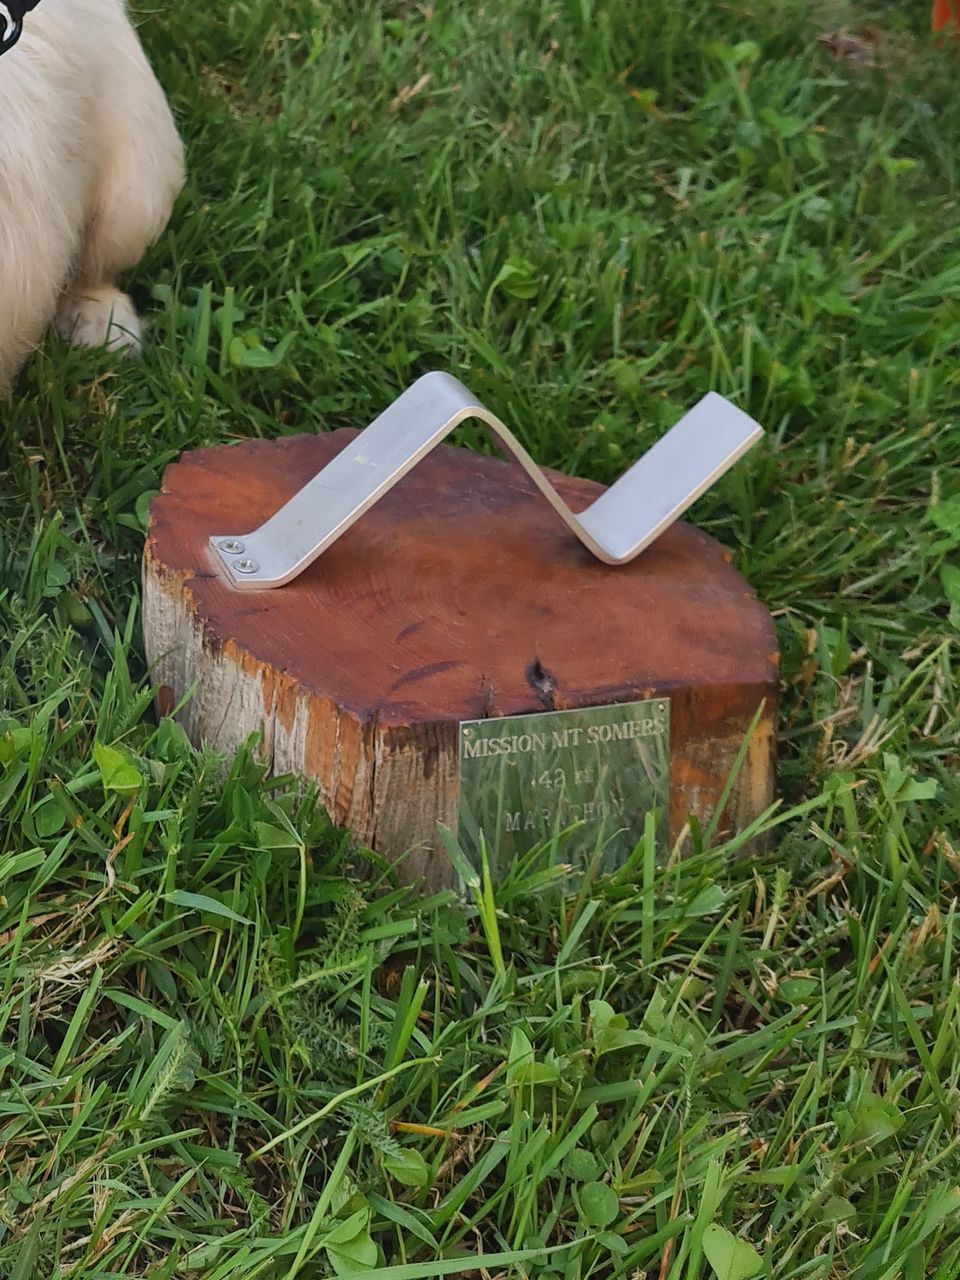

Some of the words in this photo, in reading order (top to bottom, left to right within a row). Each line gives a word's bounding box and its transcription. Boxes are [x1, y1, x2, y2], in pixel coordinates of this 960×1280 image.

[463, 733, 546, 759] MISSION
[552, 728, 583, 749] MT
[587, 717, 665, 744] SOMERS
[504, 798, 625, 832] MARTHON
